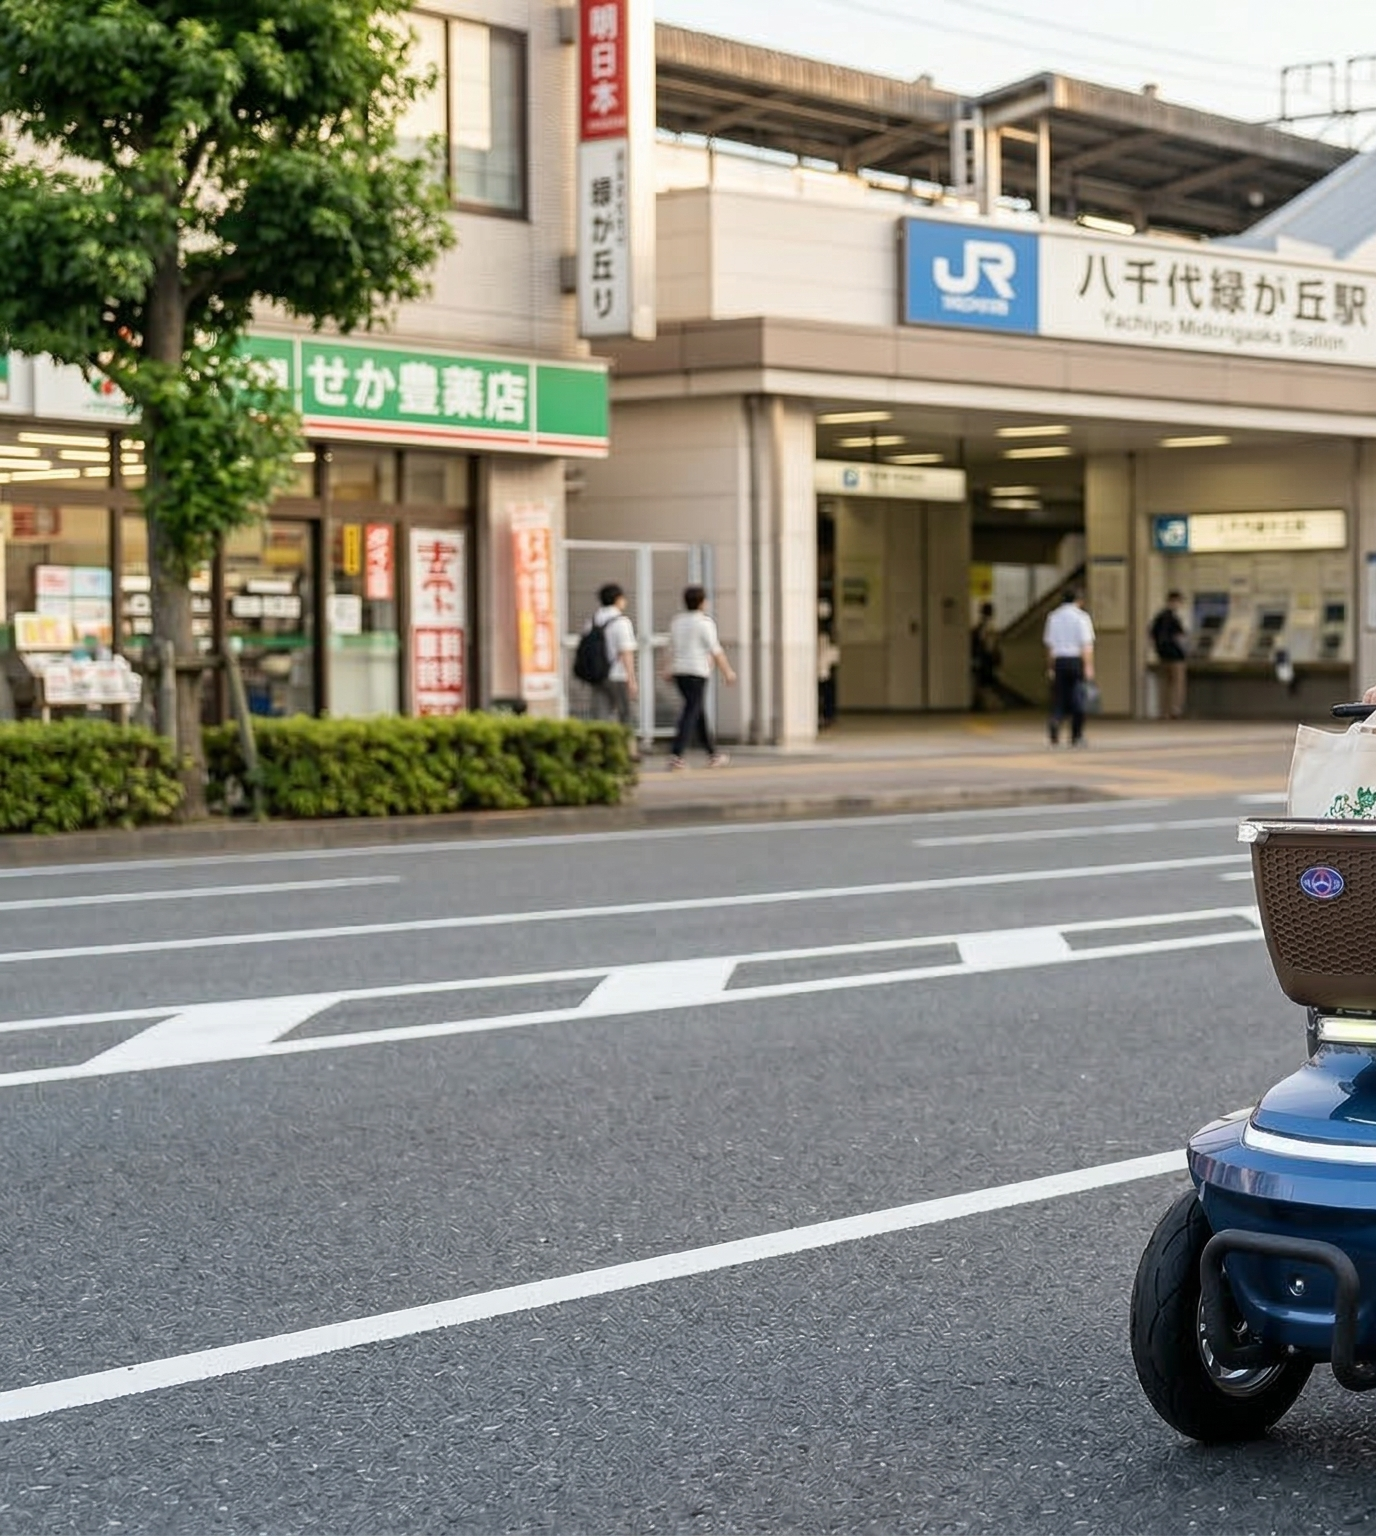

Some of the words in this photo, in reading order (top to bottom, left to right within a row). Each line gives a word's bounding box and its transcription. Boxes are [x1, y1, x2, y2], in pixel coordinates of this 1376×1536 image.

[932, 239, 1017, 300] JR
[1078, 254, 1368, 329] 八千代緑が丘駅
